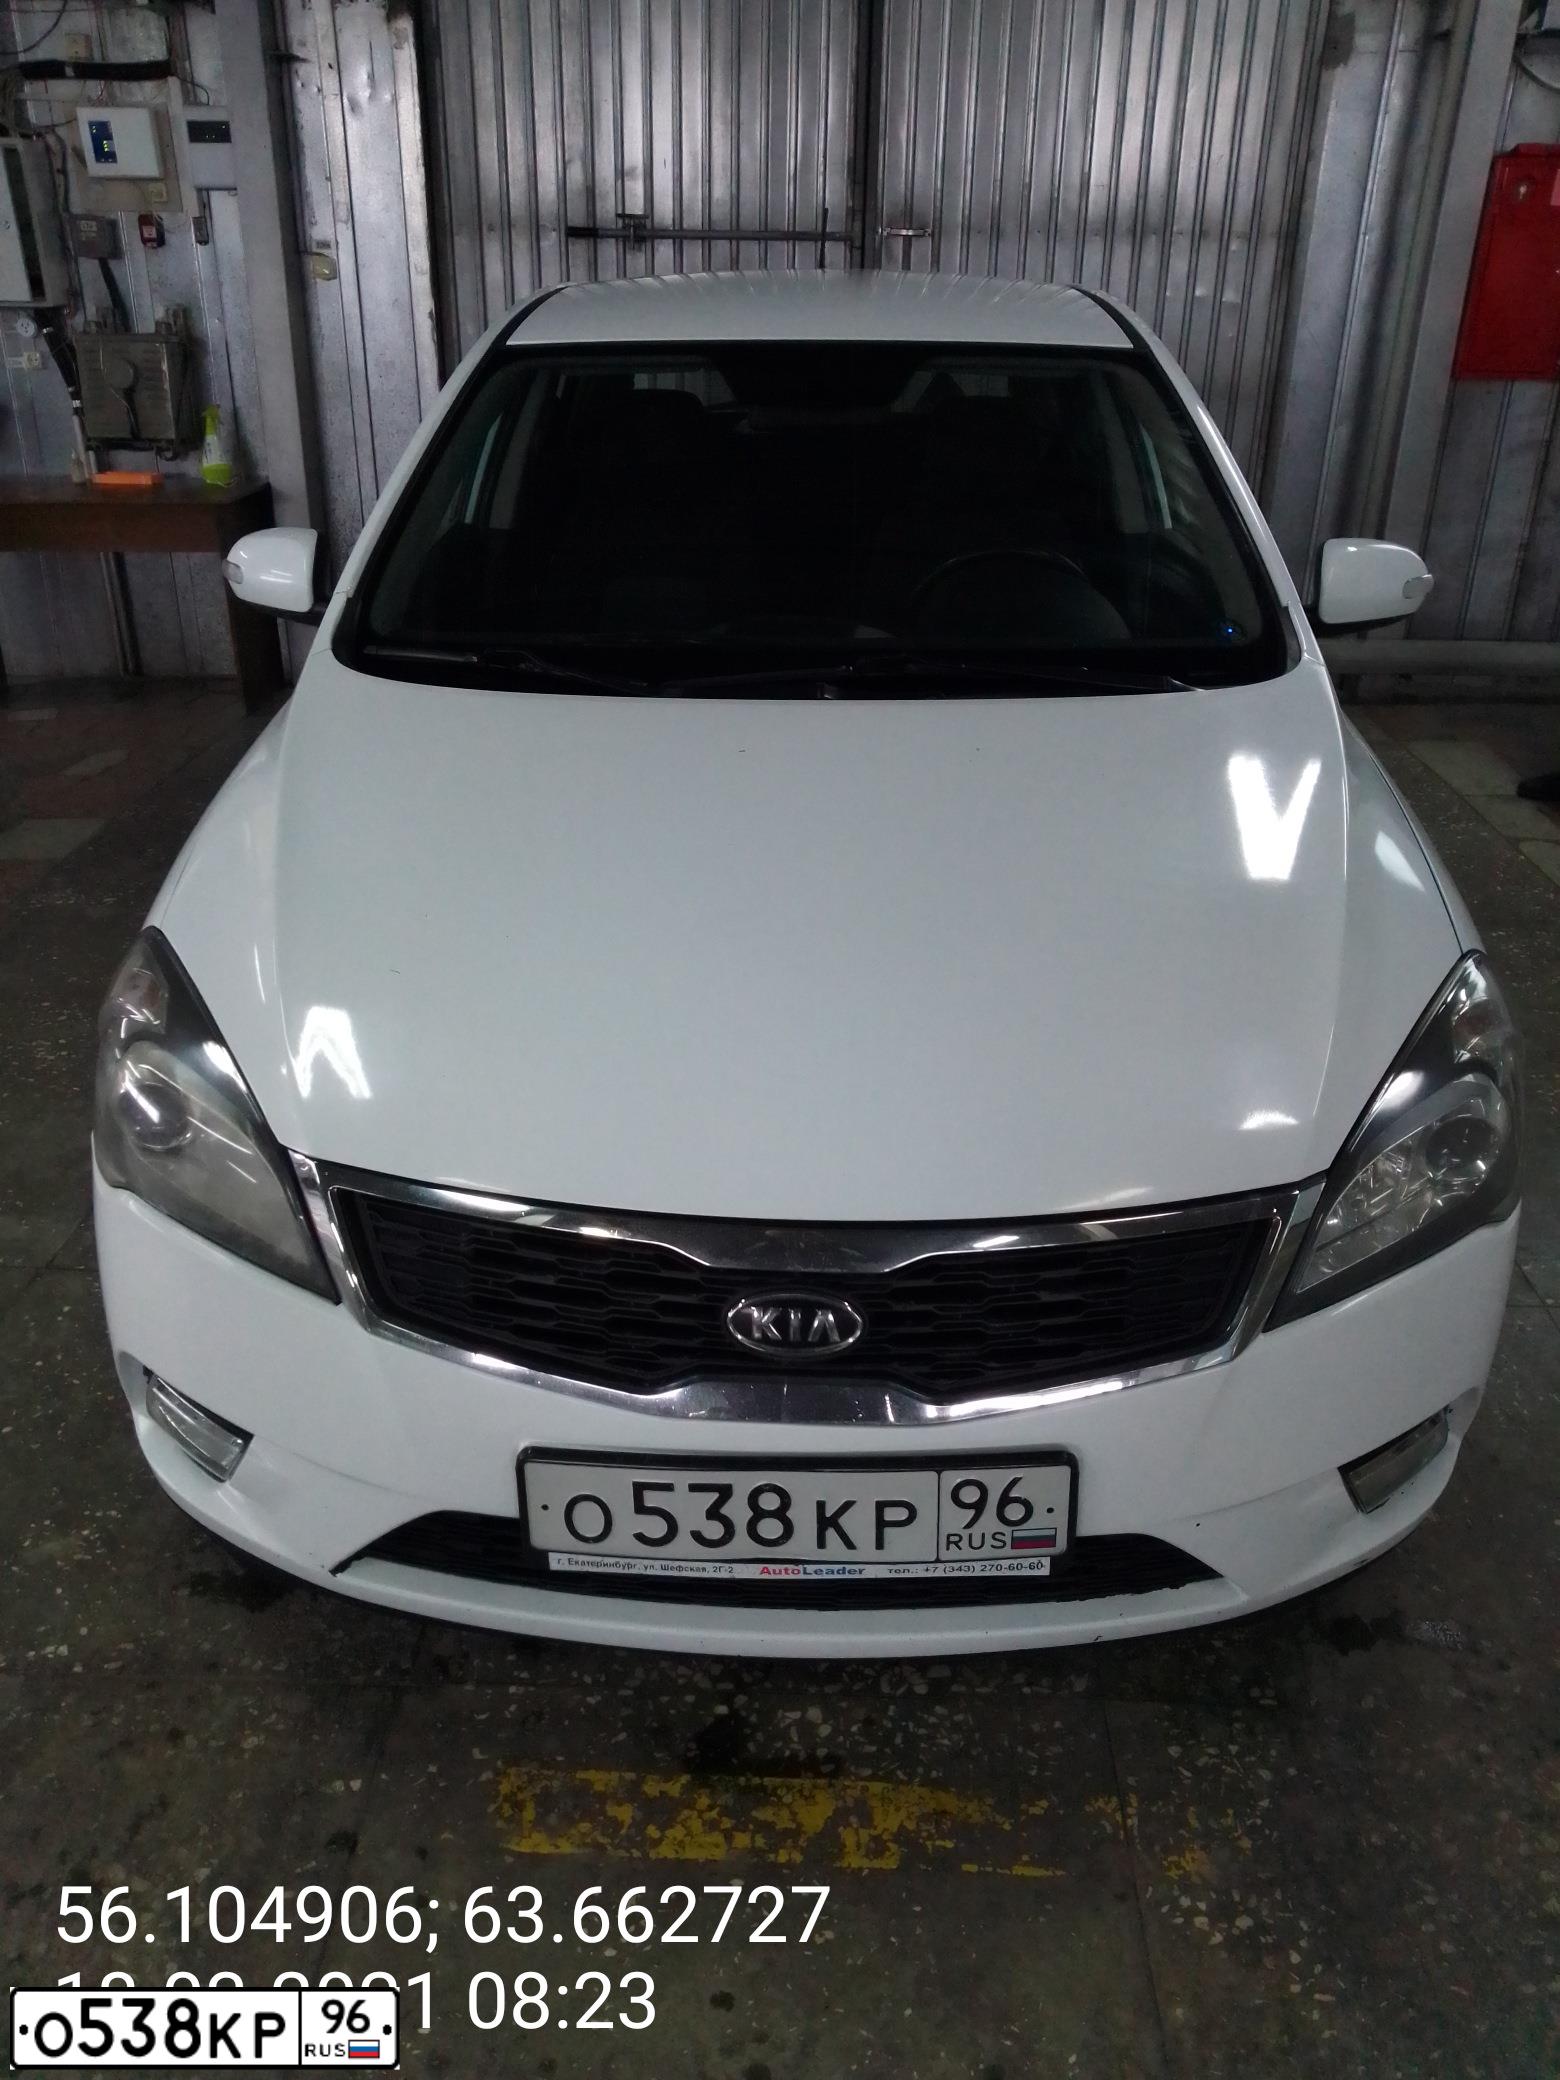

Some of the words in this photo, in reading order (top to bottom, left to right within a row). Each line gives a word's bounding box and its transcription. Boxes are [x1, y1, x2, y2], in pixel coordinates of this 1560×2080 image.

[750, 1306, 840, 1342] KIA
[950, 1476, 1034, 1529] 96
[945, 1530, 1007, 1551] RUS
[759, 1566, 866, 1576] AutoLeader
[923, 1565, 939, 1574] +7
[943, 1563, 976, 1574] (343)
[980, 1561, 1045, 1573] 270-60-60
